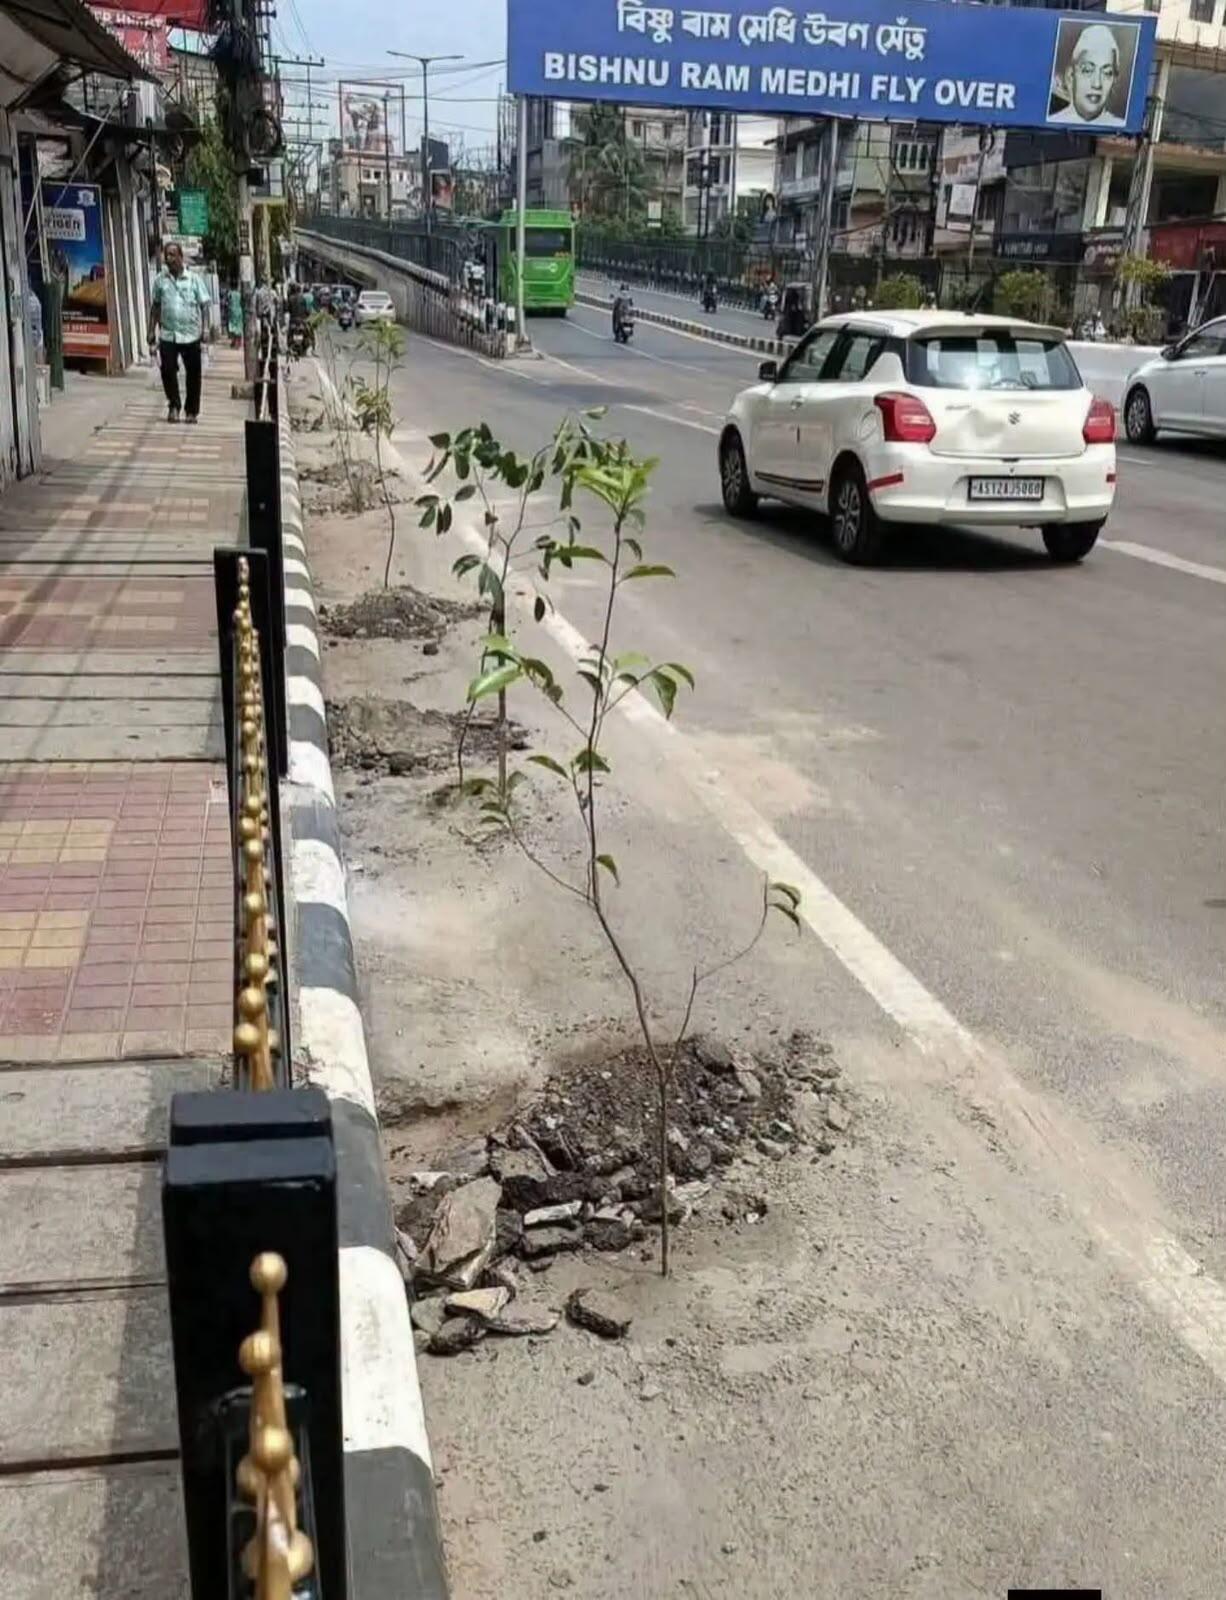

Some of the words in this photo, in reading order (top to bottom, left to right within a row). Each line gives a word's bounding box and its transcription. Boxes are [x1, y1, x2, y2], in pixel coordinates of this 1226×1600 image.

[617, 0, 674, 43] বিষ্ণু
[738, 6, 797, 45] মেধি
[875, 16, 927, 61] সেঁতু
[544, 51, 670, 87] BISHNU
[680, 61, 750, 92] RAM
[760, 66, 860, 99] MEDHI
[870, 74, 927, 104] FLY
[934, 79, 1016, 110] OVER
